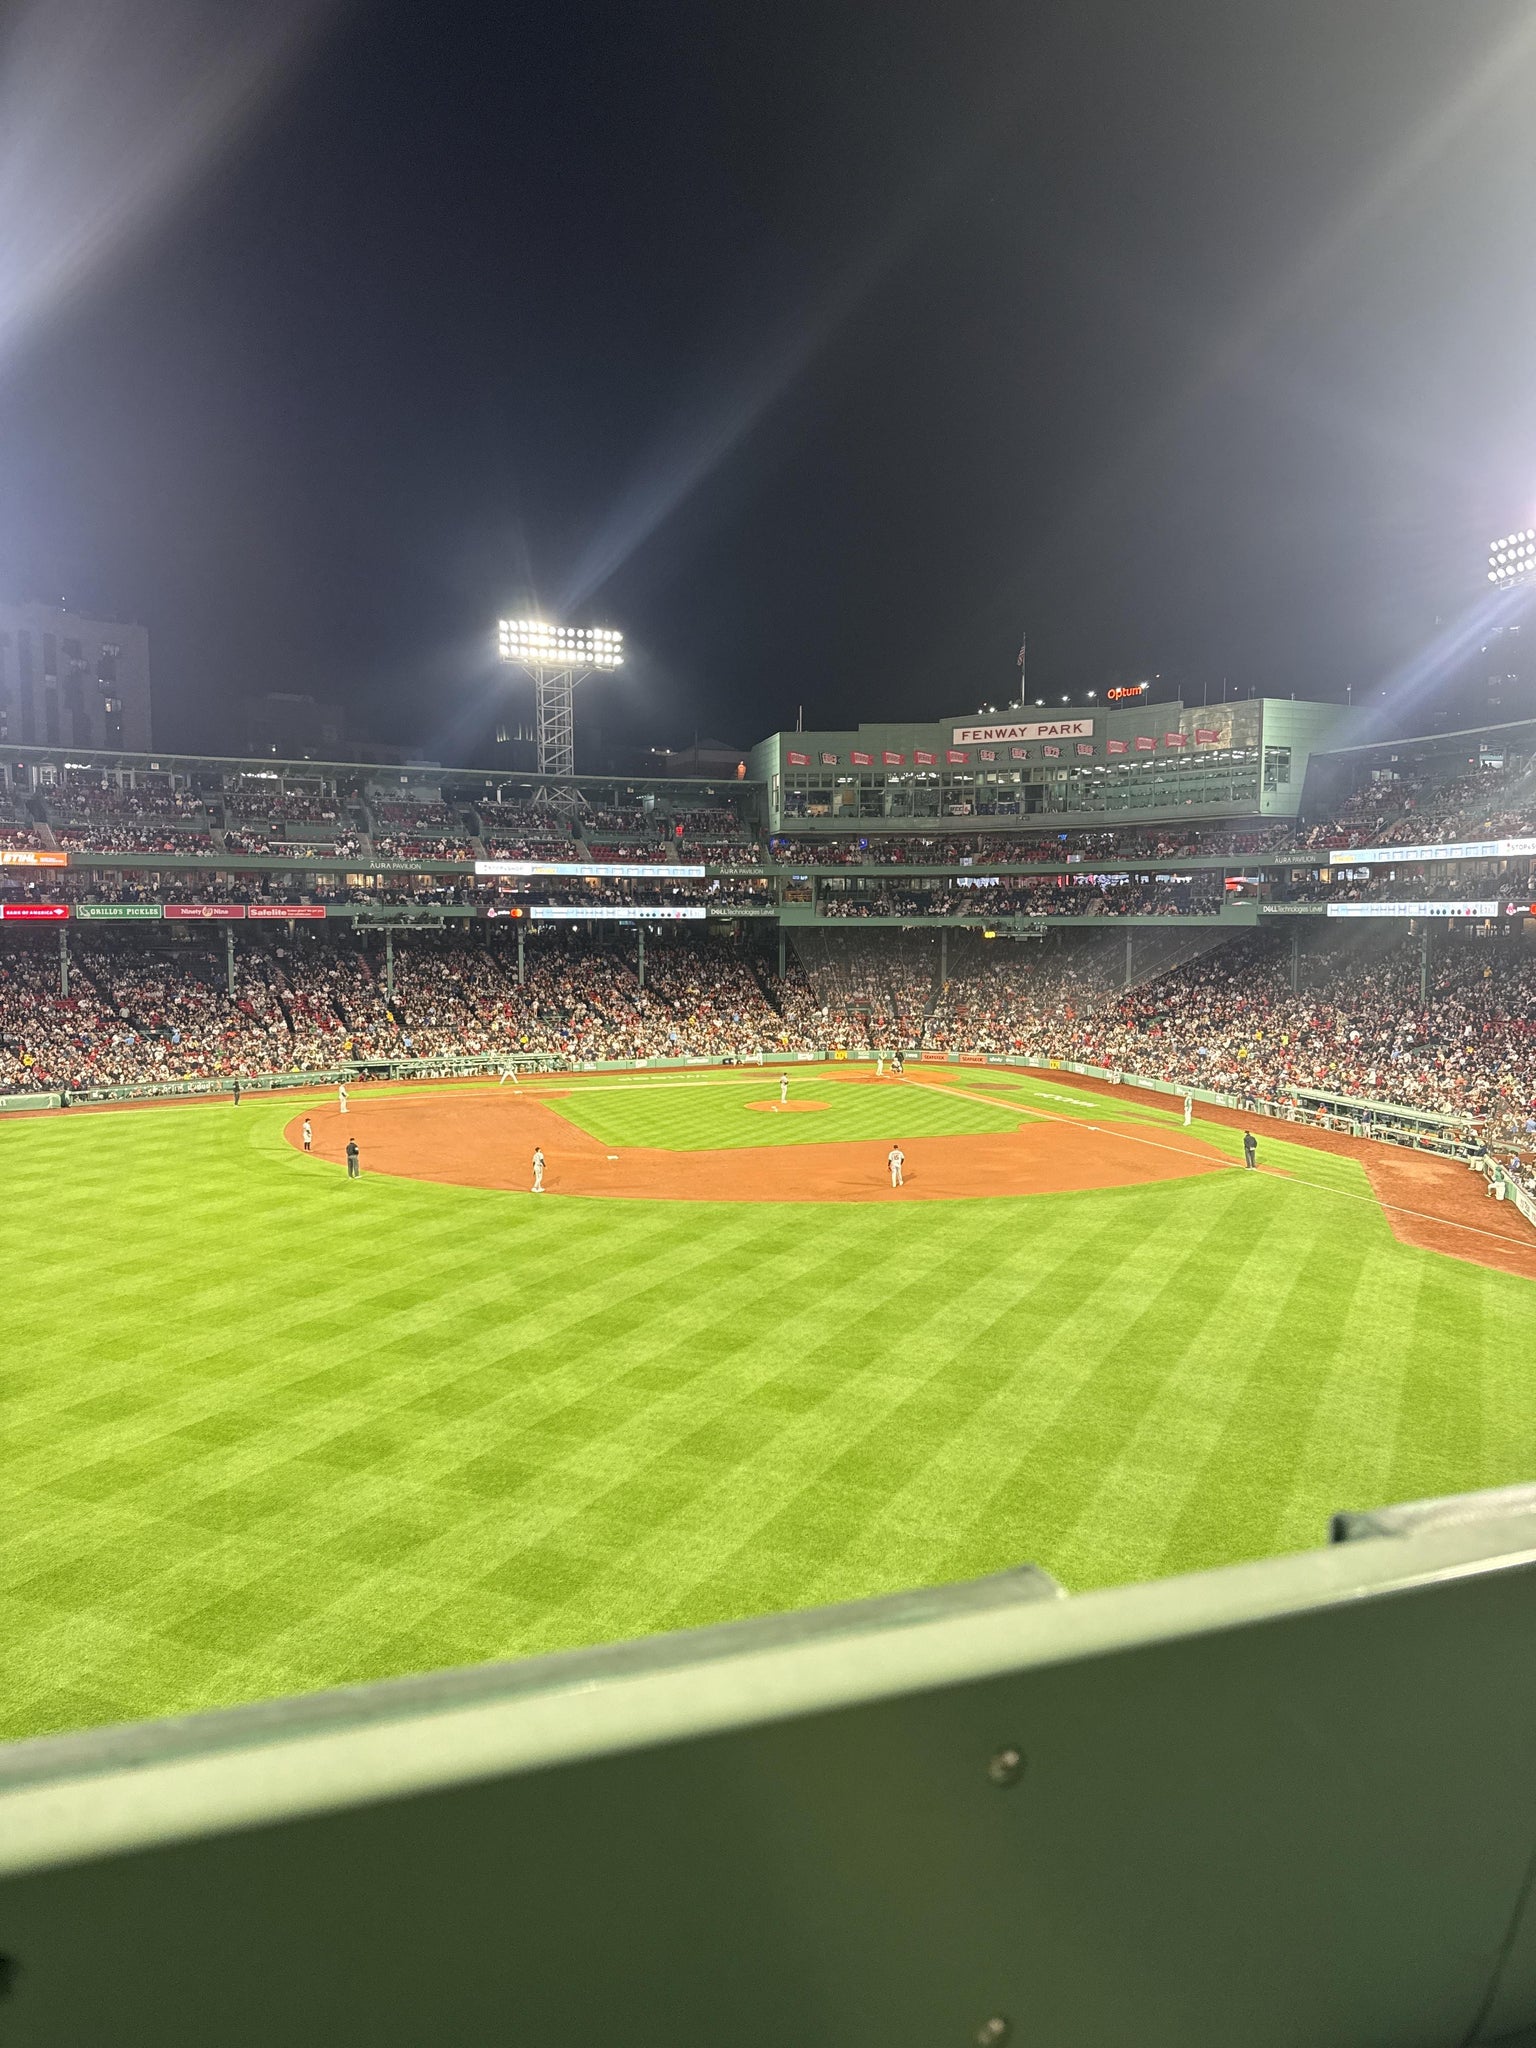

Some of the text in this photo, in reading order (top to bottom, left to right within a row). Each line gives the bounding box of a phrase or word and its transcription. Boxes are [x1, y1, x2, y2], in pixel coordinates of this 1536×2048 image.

[1107, 685, 1142, 700] Optum
[962, 723, 1083, 741] FENWAY PARK
[392, 862, 422, 870] PAVILION
[180, 908, 202, 916] Ninety
[250, 908, 287, 916] Safelite
